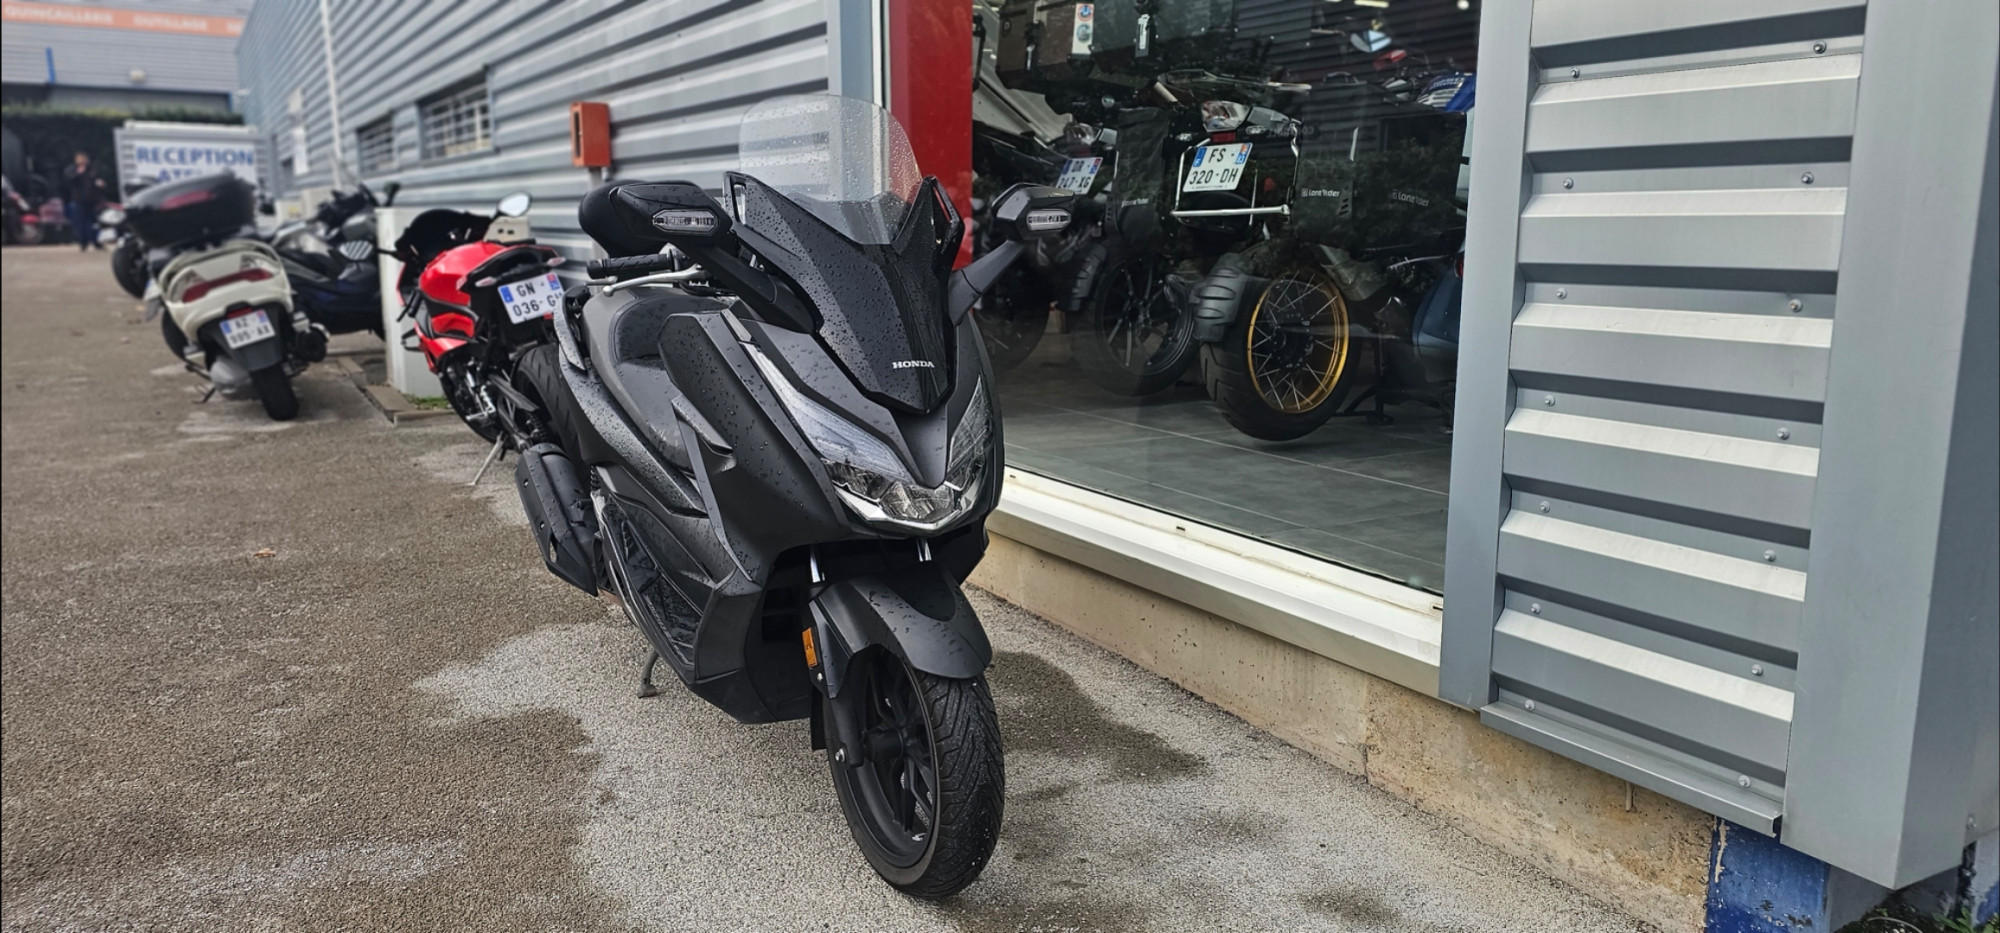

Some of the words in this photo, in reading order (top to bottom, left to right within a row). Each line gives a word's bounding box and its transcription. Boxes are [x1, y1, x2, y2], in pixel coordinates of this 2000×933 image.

[136, 146, 254, 166] RECEPTION
[1208, 148, 1226, 163] FS
[1189, 168, 1239, 185] 320-DH
[516, 282, 536, 297] GN
[512, 292, 563, 317] 036-G
[892, 360, 935, 369] HONDA
